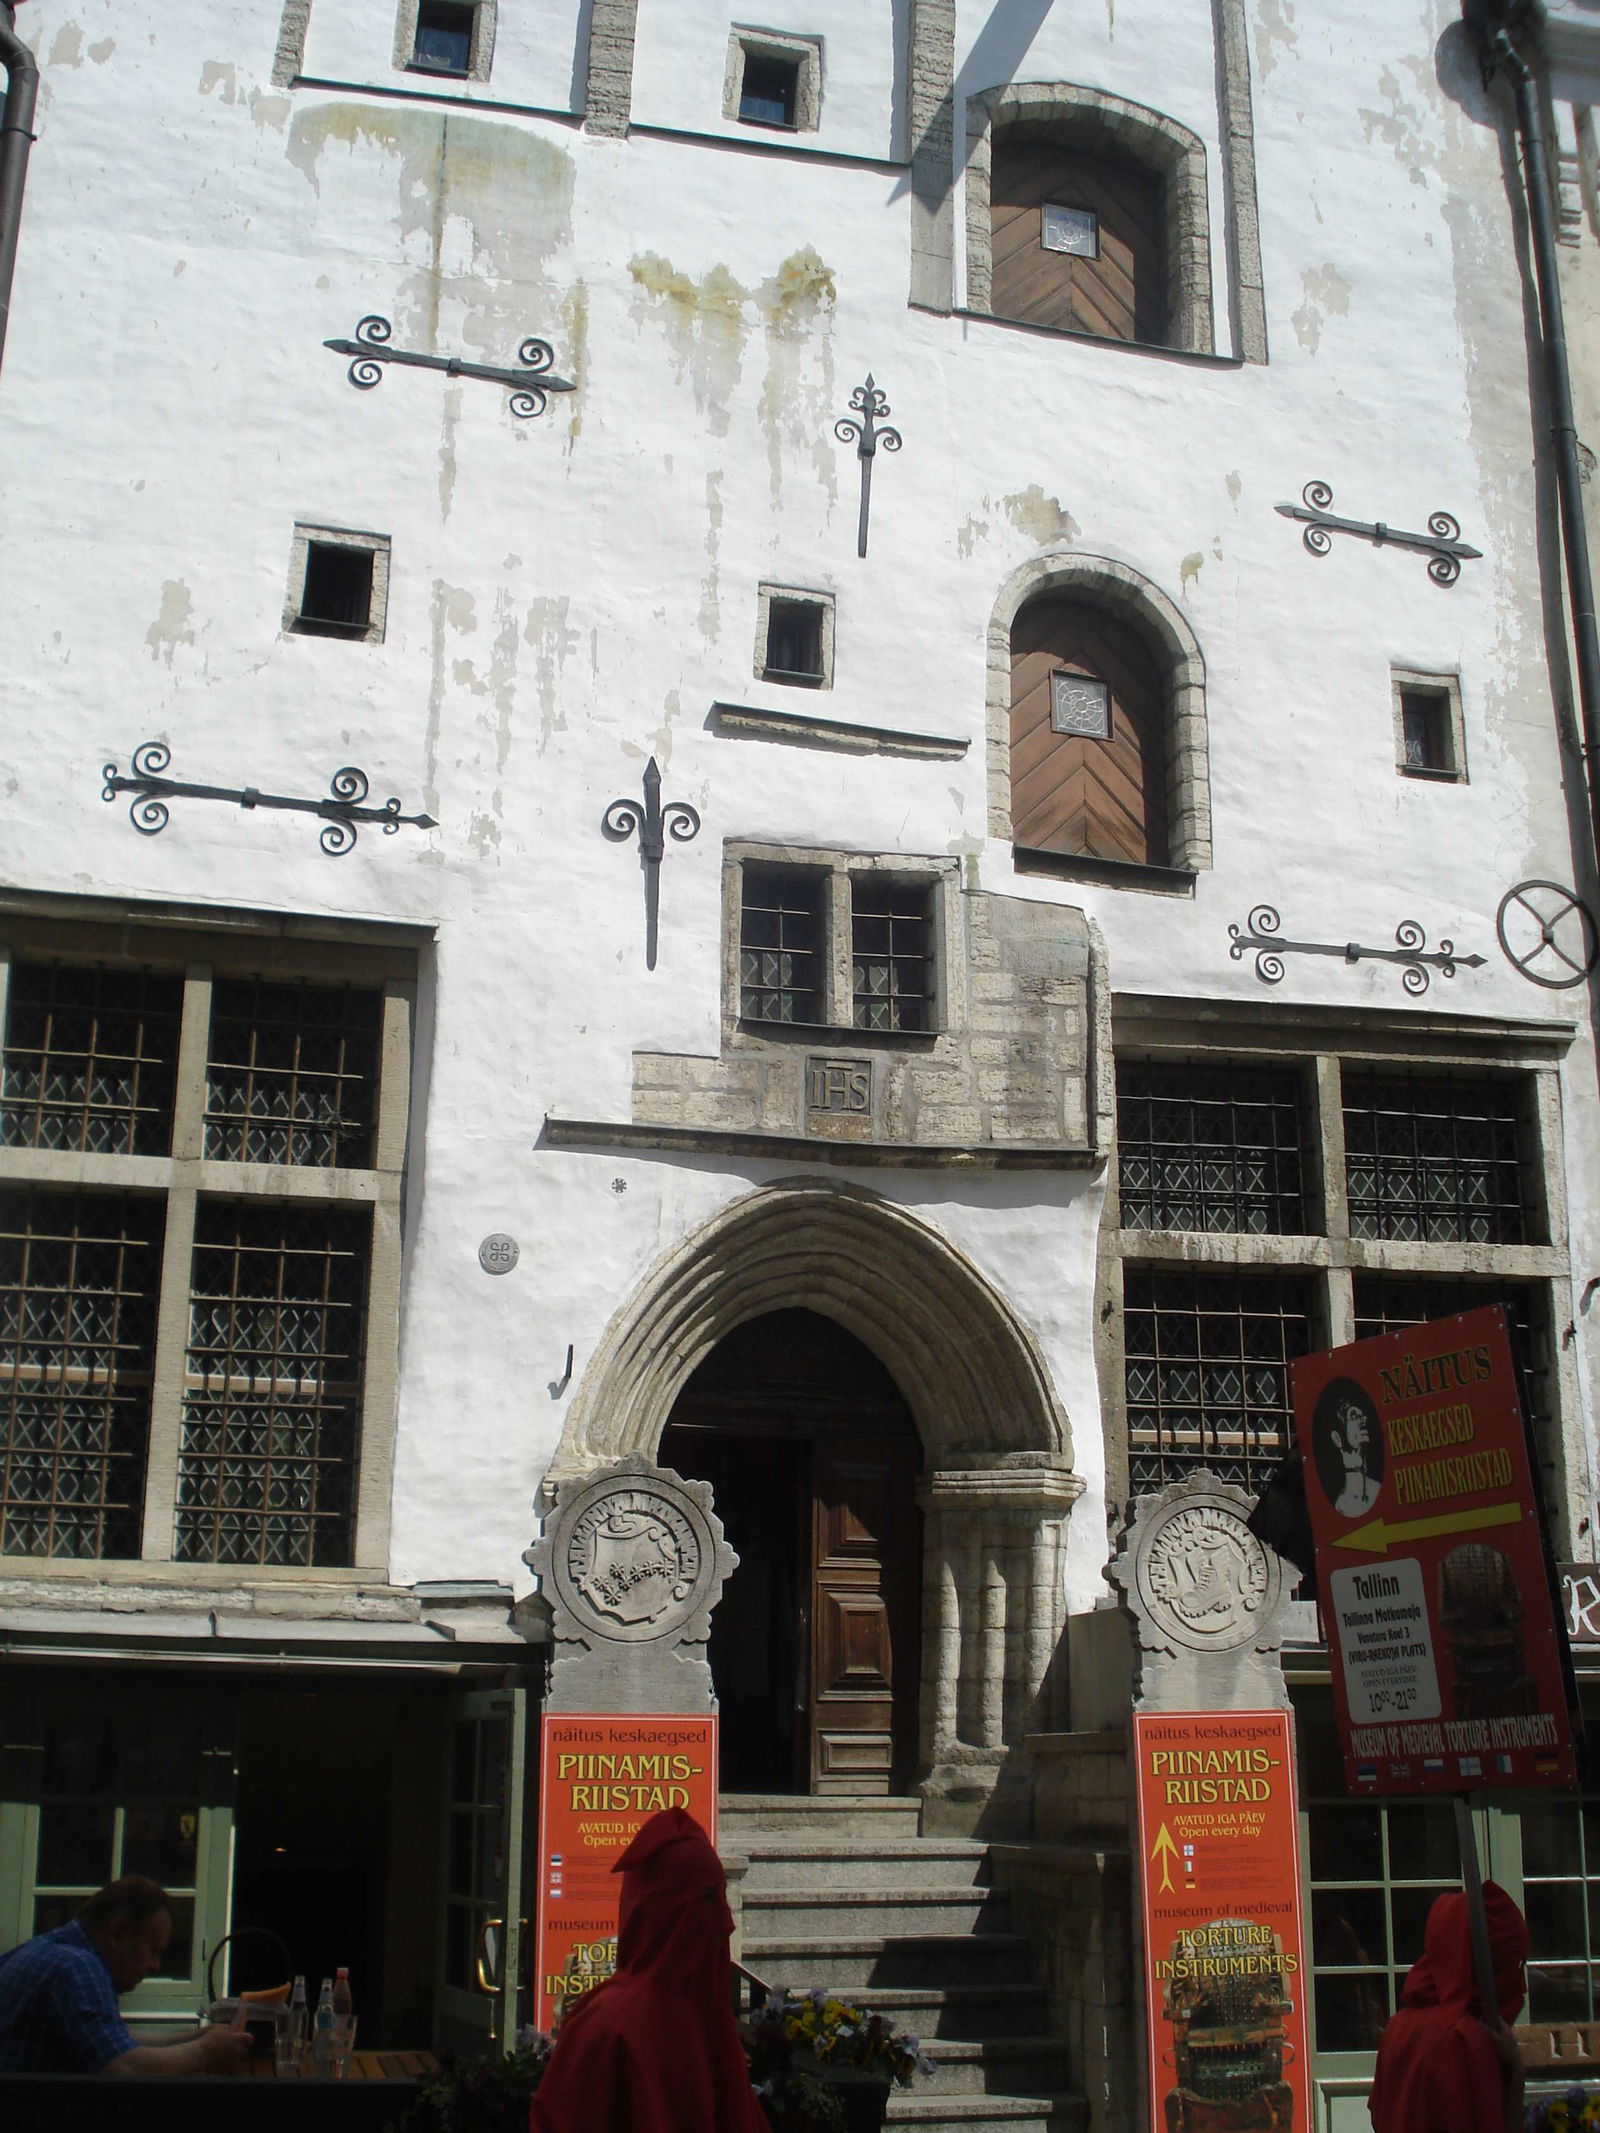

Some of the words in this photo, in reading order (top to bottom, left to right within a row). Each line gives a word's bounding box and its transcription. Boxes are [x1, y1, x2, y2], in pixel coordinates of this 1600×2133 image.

[810, 1070, 868, 1112] IHS
[1379, 1344, 1492, 1404] NÄITUS
[1387, 1404, 1475, 1456] KESKAEGSED
[1394, 1448, 1512, 1505] PIINAMISRIISTAD
[1352, 1573, 1400, 1600] Tallinn
[1342, 1612, 1374, 1628] Tallinna
[1375, 1604, 1421, 1623] Matkamaja
[1404, 1626, 1410, 1639] 3
[553, 1728, 603, 1742] näitus
[609, 1728, 706, 1746] keskaegsed
[1145, 1726, 1190, 1740] näitus
[1195, 1724, 1281, 1741] keskaegsed
[1350, 1728, 1386, 1758] MUSEUM
[1387, 1727, 1400, 1756] OF
[1401, 1723, 1446, 1755] MEDIEVAL
[1444, 1719, 1490, 1753] TORTURE
[1490, 1713, 1559, 1751] INSTRUMENTS
[557, 1753, 703, 1780] PIINAMIS-
[1151, 1748, 1281, 1775] PIINAMIS-
[570, 1785, 690, 1811] RIISTAD
[1165, 1778, 1271, 1804] RIISTAD
[577, 1822, 624, 1833] AVATUD
[627, 1823, 642, 1833] IG
[1173, 1815, 1214, 1825] AVATUD
[1217, 1814, 1236, 1824] IGA
[1239, 1811, 1266, 1824] PÄEV
[583, 1835, 616, 1847] Open
[1179, 1827, 1208, 1839] Open
[1211, 1827, 1240, 1838] every
[1242, 1825, 1261, 1837] day
[1154, 1907, 1213, 1919] museum
[1217, 1903, 1232, 1915] of
[1234, 1901, 1292, 1916] medieval
[548, 1919, 614, 1931] museum
[1176, 1925, 1273, 1948] TORTURE
[1154, 1953, 1298, 1980] INSTRUMENTS
